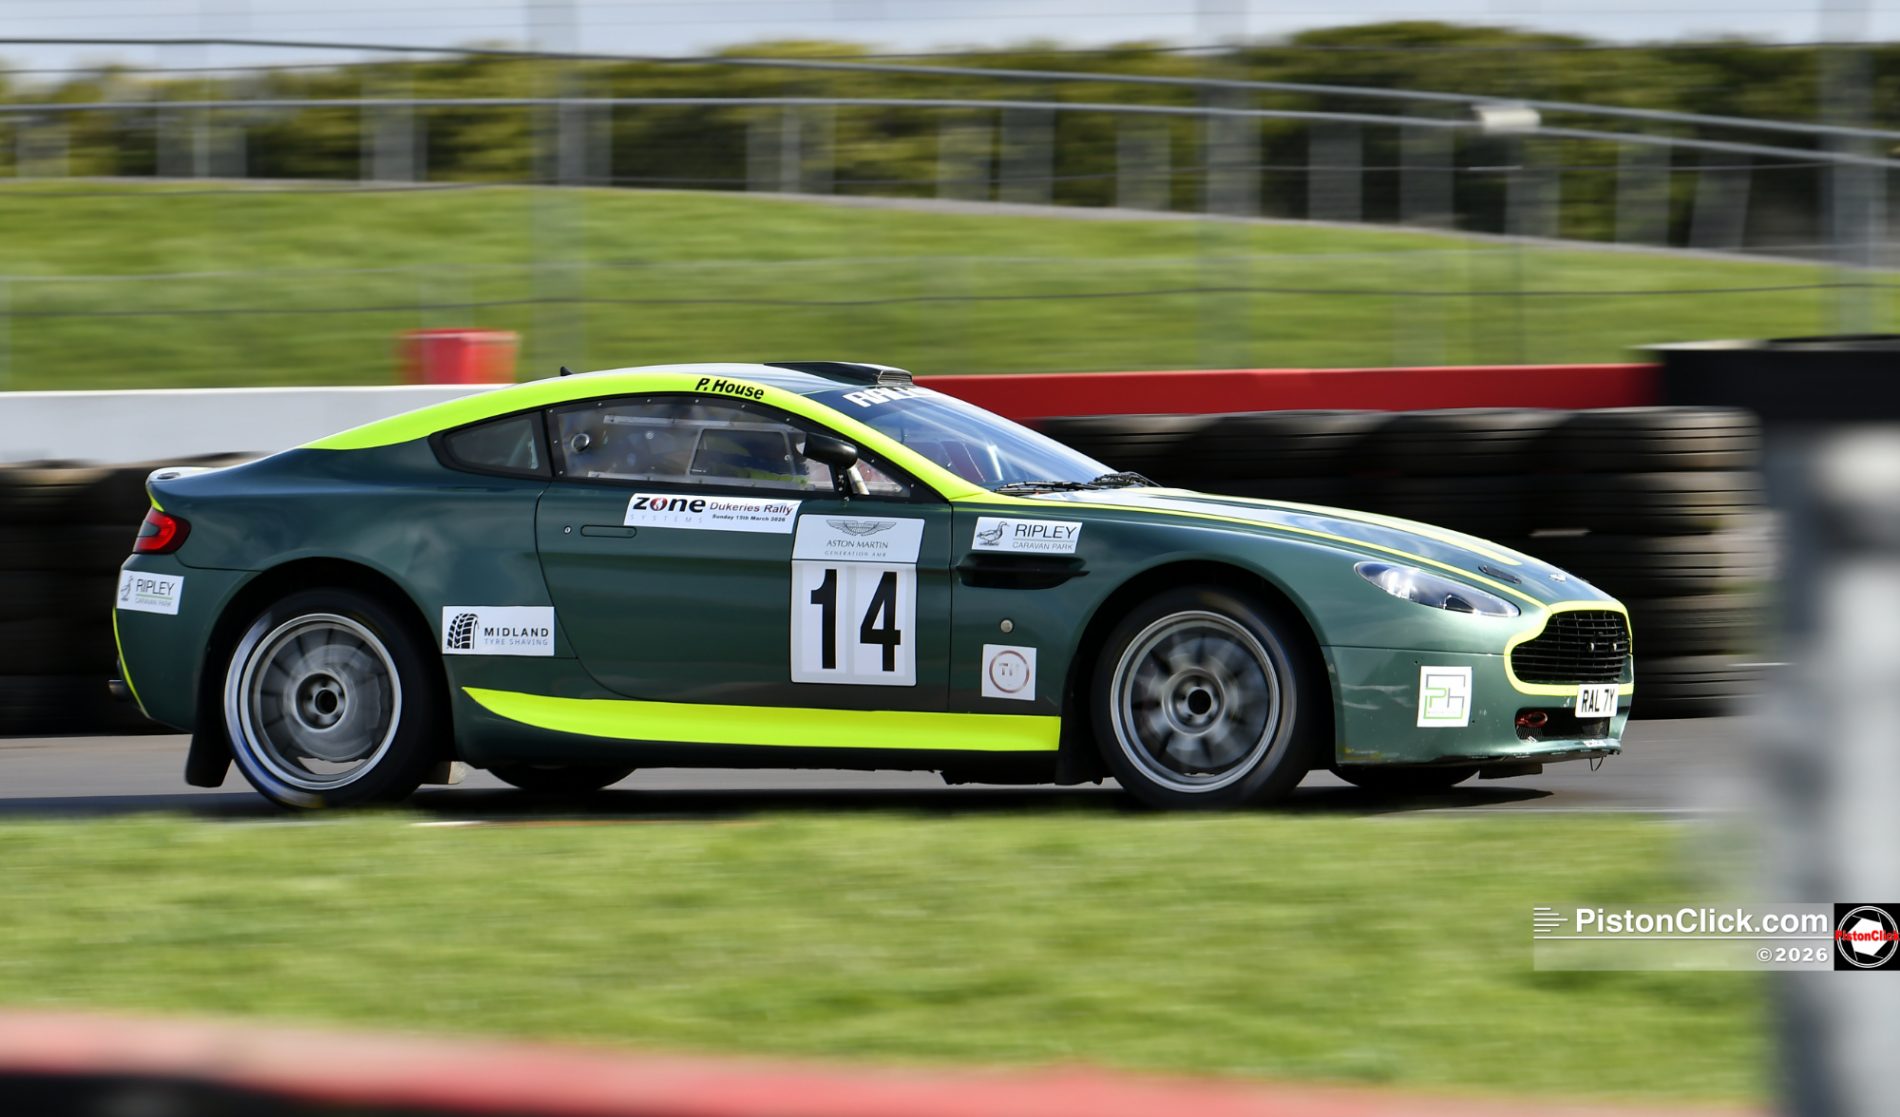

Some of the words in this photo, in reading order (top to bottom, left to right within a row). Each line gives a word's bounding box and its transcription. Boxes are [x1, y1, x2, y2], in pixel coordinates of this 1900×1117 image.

[695, 378, 710, 391] P.
[711, 379, 765, 400] House
[632, 496, 707, 513] zone
[709, 501, 760, 513] Dukeries
[763, 504, 793, 516] Rally
[711, 513, 734, 521] Sunday
[1014, 523, 1078, 539] RIPLEY
[826, 539, 855, 548] ASTON
[856, 540, 889, 549] MARTIN
[1012, 541, 1050, 550] CARAVAN
[1051, 542, 1073, 550] PARK
[135, 578, 175, 595] RIPLEY
[810, 568, 902, 672] 14
[483, 627, 549, 637] MIDLAND
[483, 638, 508, 646] TYRE
[509, 638, 549, 647] SHAVING
[1581, 688, 1600, 713] RAL
[1603, 688, 1616, 713] 7Y
